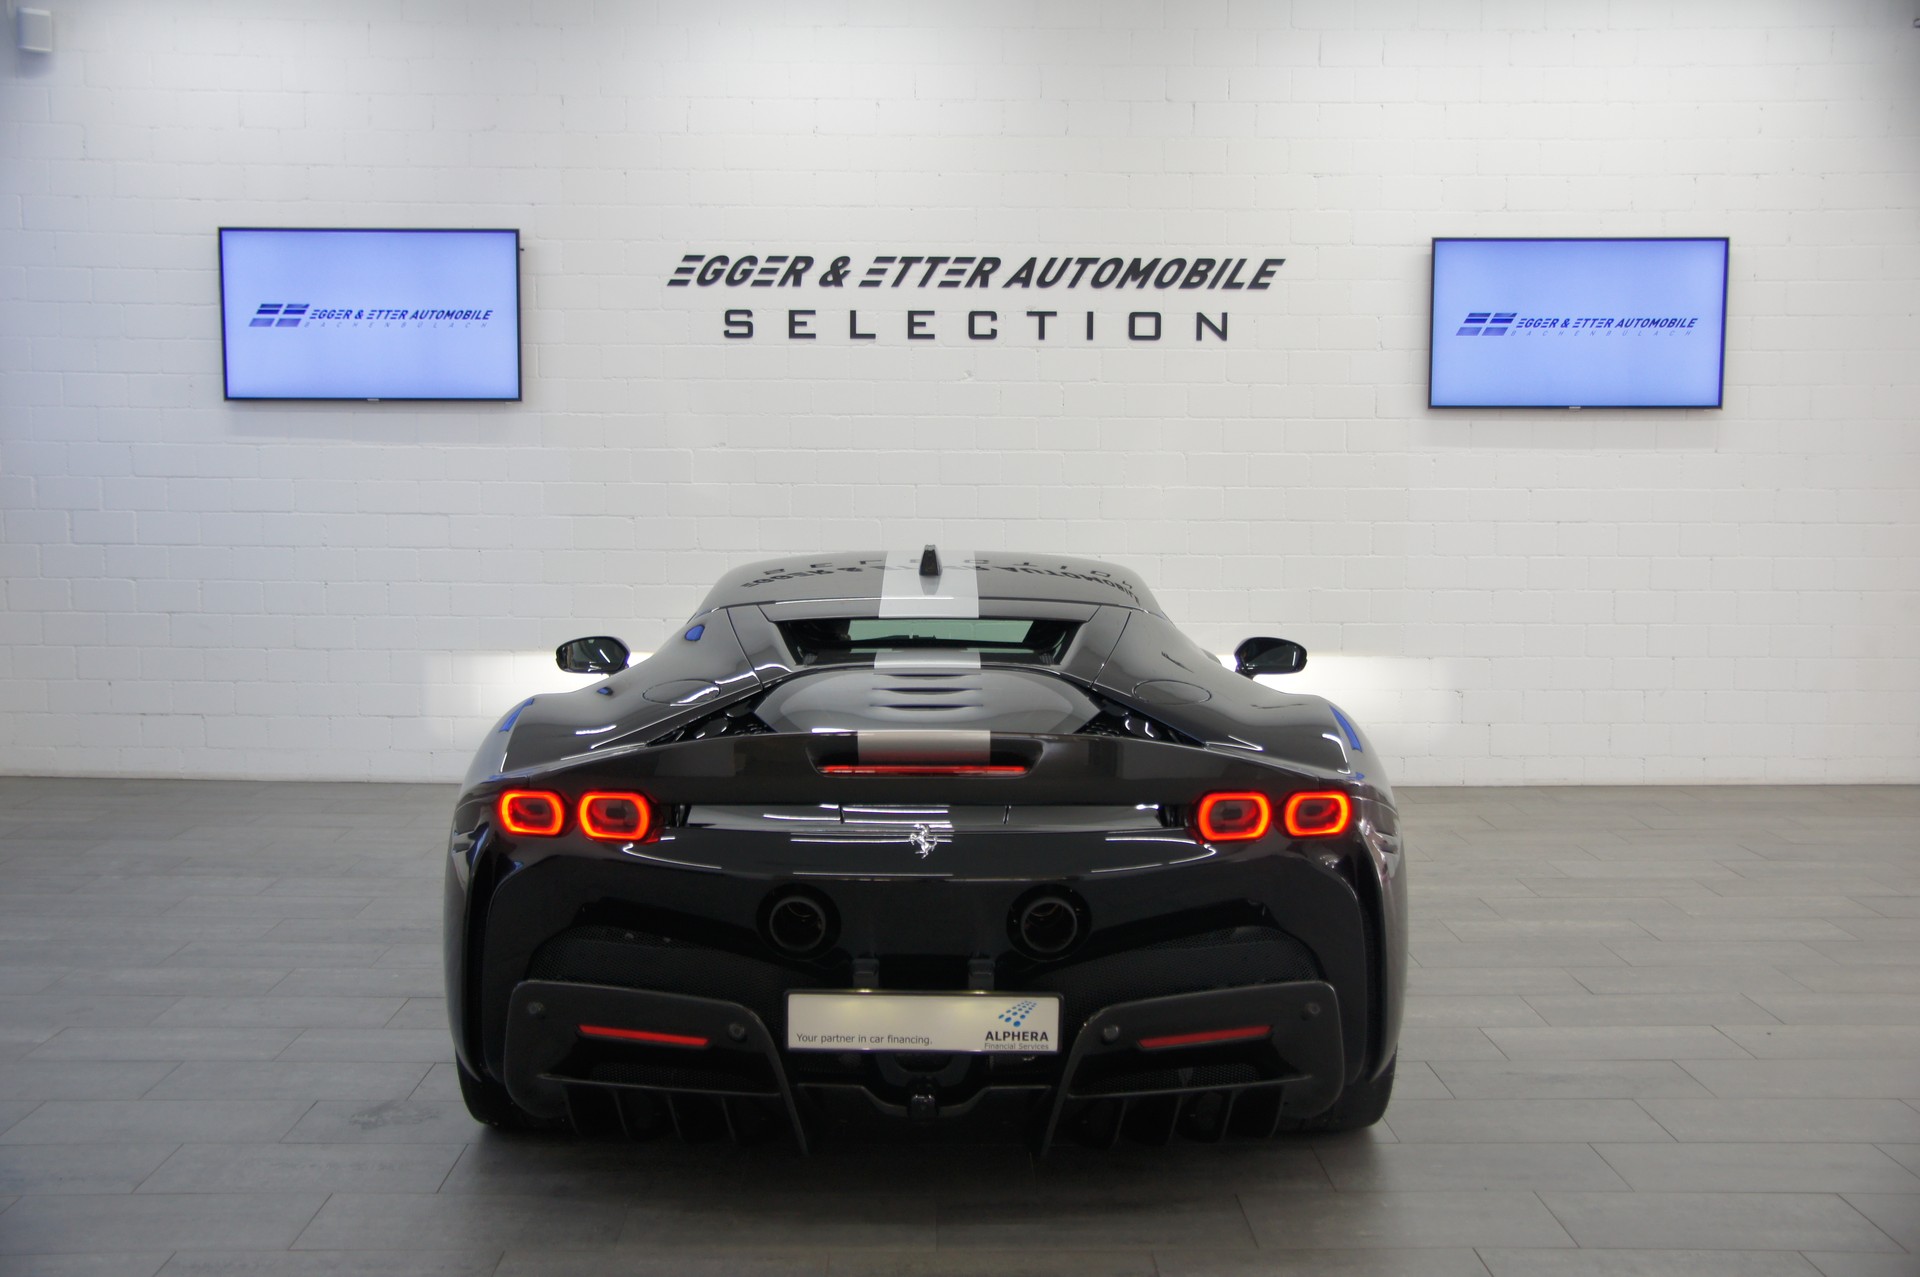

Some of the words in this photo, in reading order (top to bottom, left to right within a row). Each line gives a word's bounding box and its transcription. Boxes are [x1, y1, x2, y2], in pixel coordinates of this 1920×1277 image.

[667, 254, 814, 287] EGGER
[818, 255, 851, 288] &
[858, 256, 1001, 288] ETTER
[1002, 257, 1286, 290] AUTOMOBILE
[309, 309, 352, 320] EGGER
[354, 309, 364, 320] &
[366, 309, 409, 320] ETTER
[409, 309, 493, 321] AUTOMOBILE
[723, 308, 1229, 342] SELECTION
[1516, 318, 1558, 329] EGGER
[1560, 318, 1570, 329] &
[1572, 318, 1615, 329] ETTER
[1615, 317, 1698, 329] AUTOMOBILE
[796, 1033, 817, 1043] Your
[820, 1034, 855, 1045] partner
[858, 1034, 867, 1043] in
[869, 1036, 885, 1044] car
[887, 1035, 933, 1047] financing.
[985, 1031, 1049, 1042] ALPHERA
[984, 1042, 1016, 1050] Financial
[1018, 1043, 1049, 1051] Services
